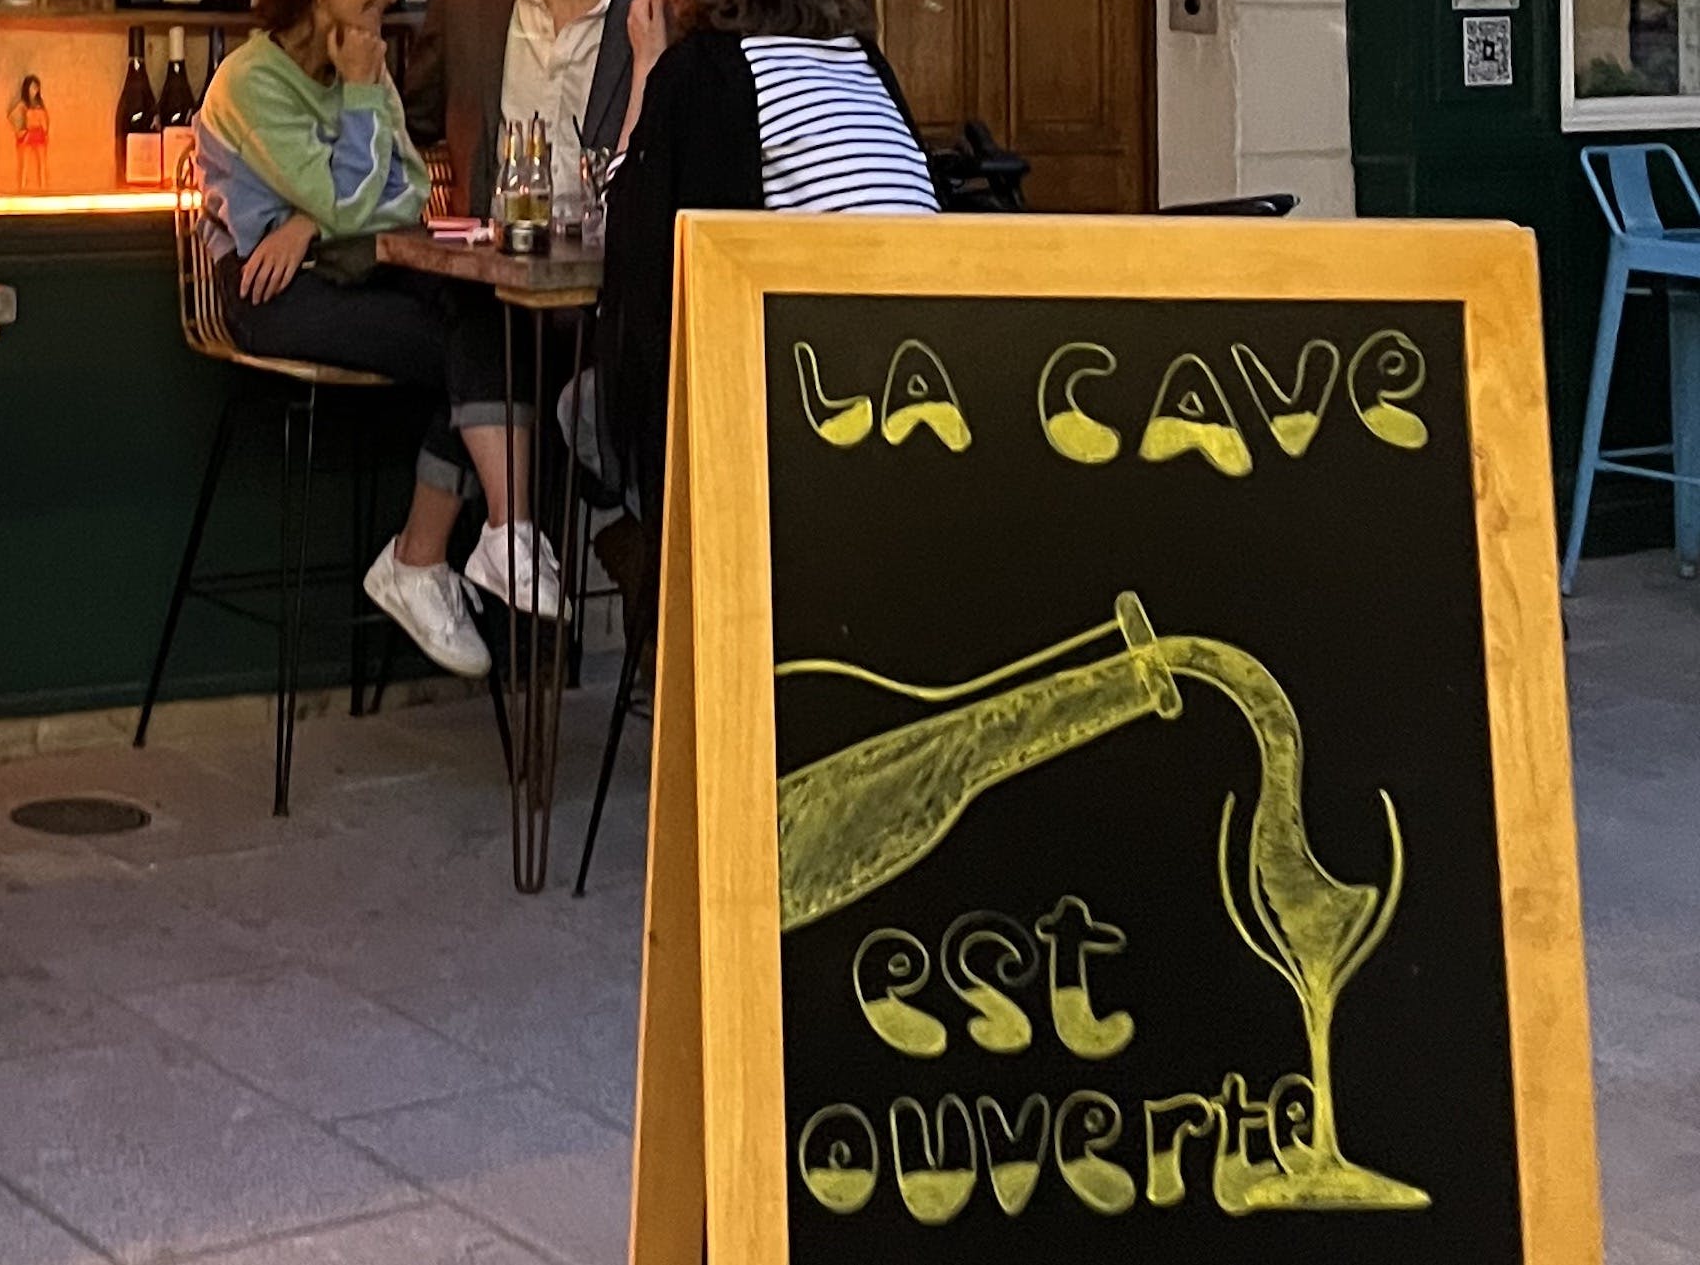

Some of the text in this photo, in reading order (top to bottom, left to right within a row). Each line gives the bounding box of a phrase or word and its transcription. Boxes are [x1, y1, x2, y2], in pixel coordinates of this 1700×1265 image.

[794, 339, 972, 452] LA
[853, 895, 1135, 1058] est
[800, 1072, 1322, 1224] ouverte
